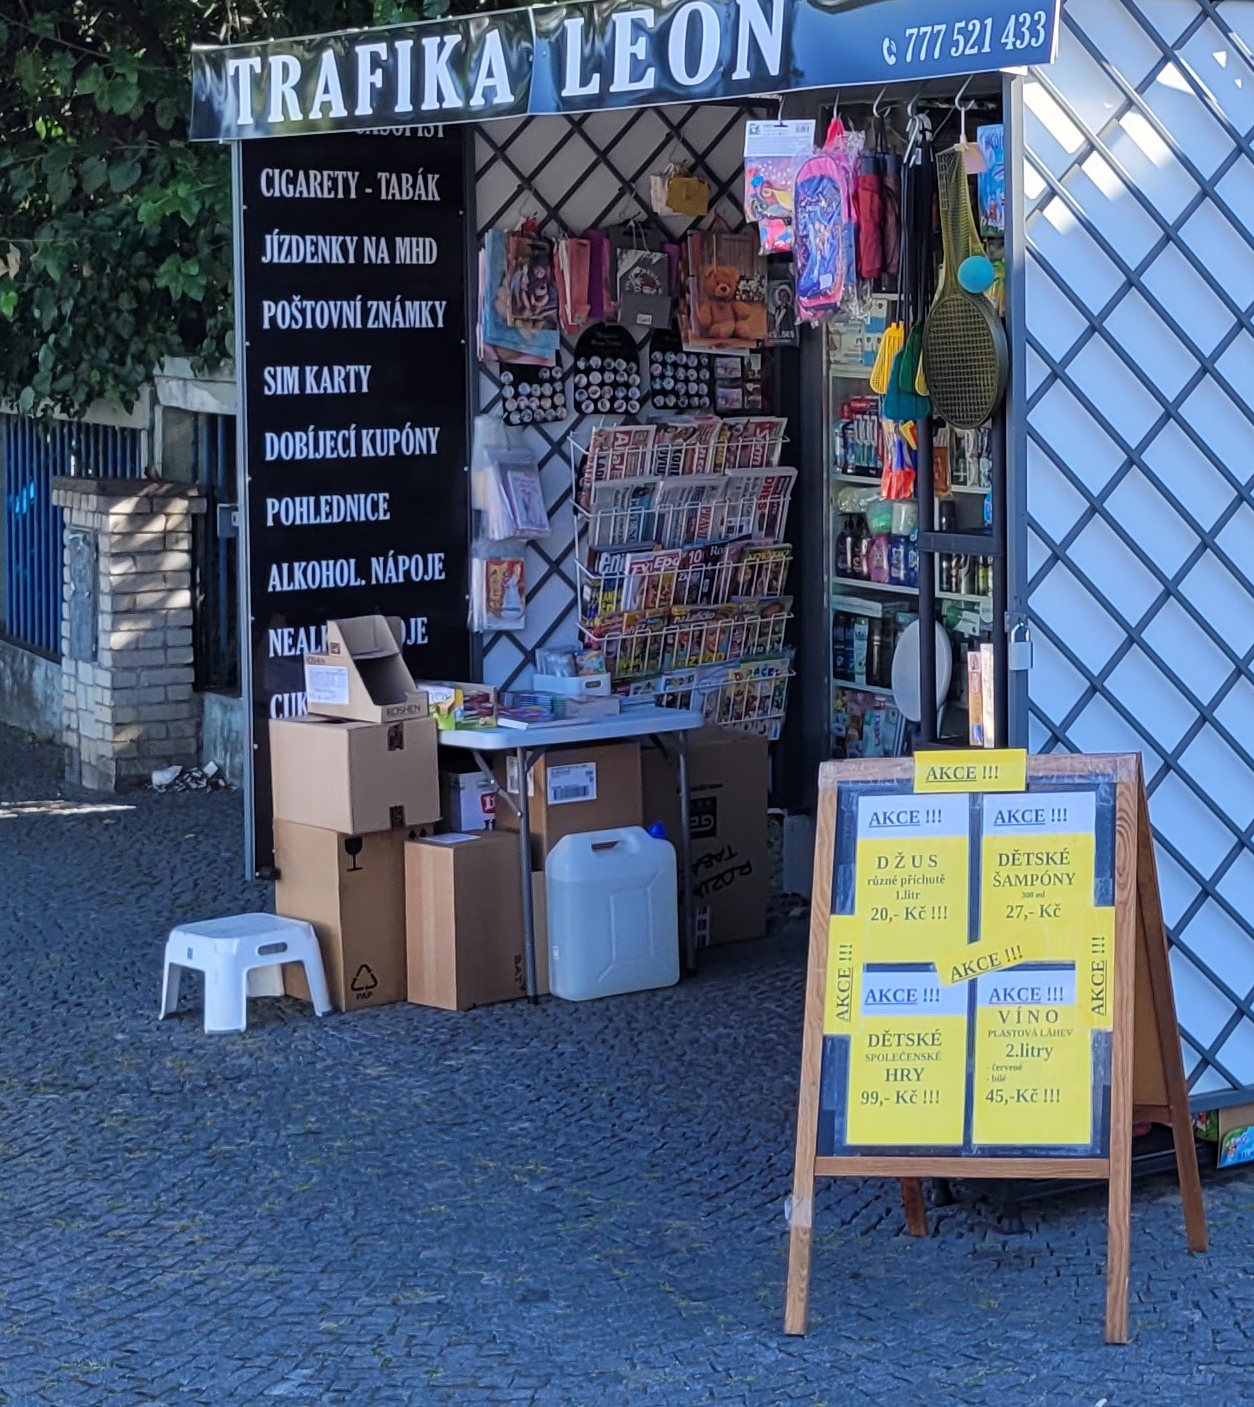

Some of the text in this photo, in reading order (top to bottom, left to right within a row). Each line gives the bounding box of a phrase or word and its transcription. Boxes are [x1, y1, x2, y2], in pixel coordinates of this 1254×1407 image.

[904, 10, 1045, 63] 777 521 433
[229, 29, 515, 126] TRAFIKA
[260, 167, 359, 200] CIGARETY
[377, 167, 441, 201] TABÁK
[261, 229, 438, 265] JÍZDENKY NA MHD
[262, 295, 447, 329] POŠTOVNÍ ZNÁMKY
[263, 365, 372, 395] SIM KARTY
[264, 422, 440, 461] DOBÍJECÍ KUPÓNY
[266, 492, 391, 527] POHLEDNICE
[267, 550, 446, 592] ALKOHOL. NÁPOJE
[925, 765, 1000, 782] AKCE !!!
[868, 809, 943, 826] AKCE !!!
[993, 807, 1068, 825] AKCE !!!
[997, 848, 1071, 867] DĚTSKÉ
[867, 873, 946, 888] různé příchutě
[992, 870, 1076, 888] ŠAMPÓNY
[895, 889, 921, 901] 1.litr
[870, 905, 948, 923] 20,- Kč !!!
[1005, 903, 1062, 922] 27,- Kč
[950, 945, 1023, 983] AKCE !!!
[836, 944, 854, 1022] AKCE !!!
[1091, 936, 1107, 1016] AKCE !!!
[865, 987, 940, 1005] AKCE !!!
[989, 986, 1064, 1004] AKCE !!!
[868, 1029, 942, 1047] DĚTSKÉ
[988, 1028, 1073, 1038] PLASTOVÁ LÁHEV
[865, 1051, 942, 1062] SPOLEČENSKÉ
[1005, 1043, 1054, 1061] 2.litry
[885, 1067, 925, 1083] HRY
[861, 1088, 940, 1107] 99,- Kč !!!
[985, 1087, 1061, 1104] 45,-Kč !!!
